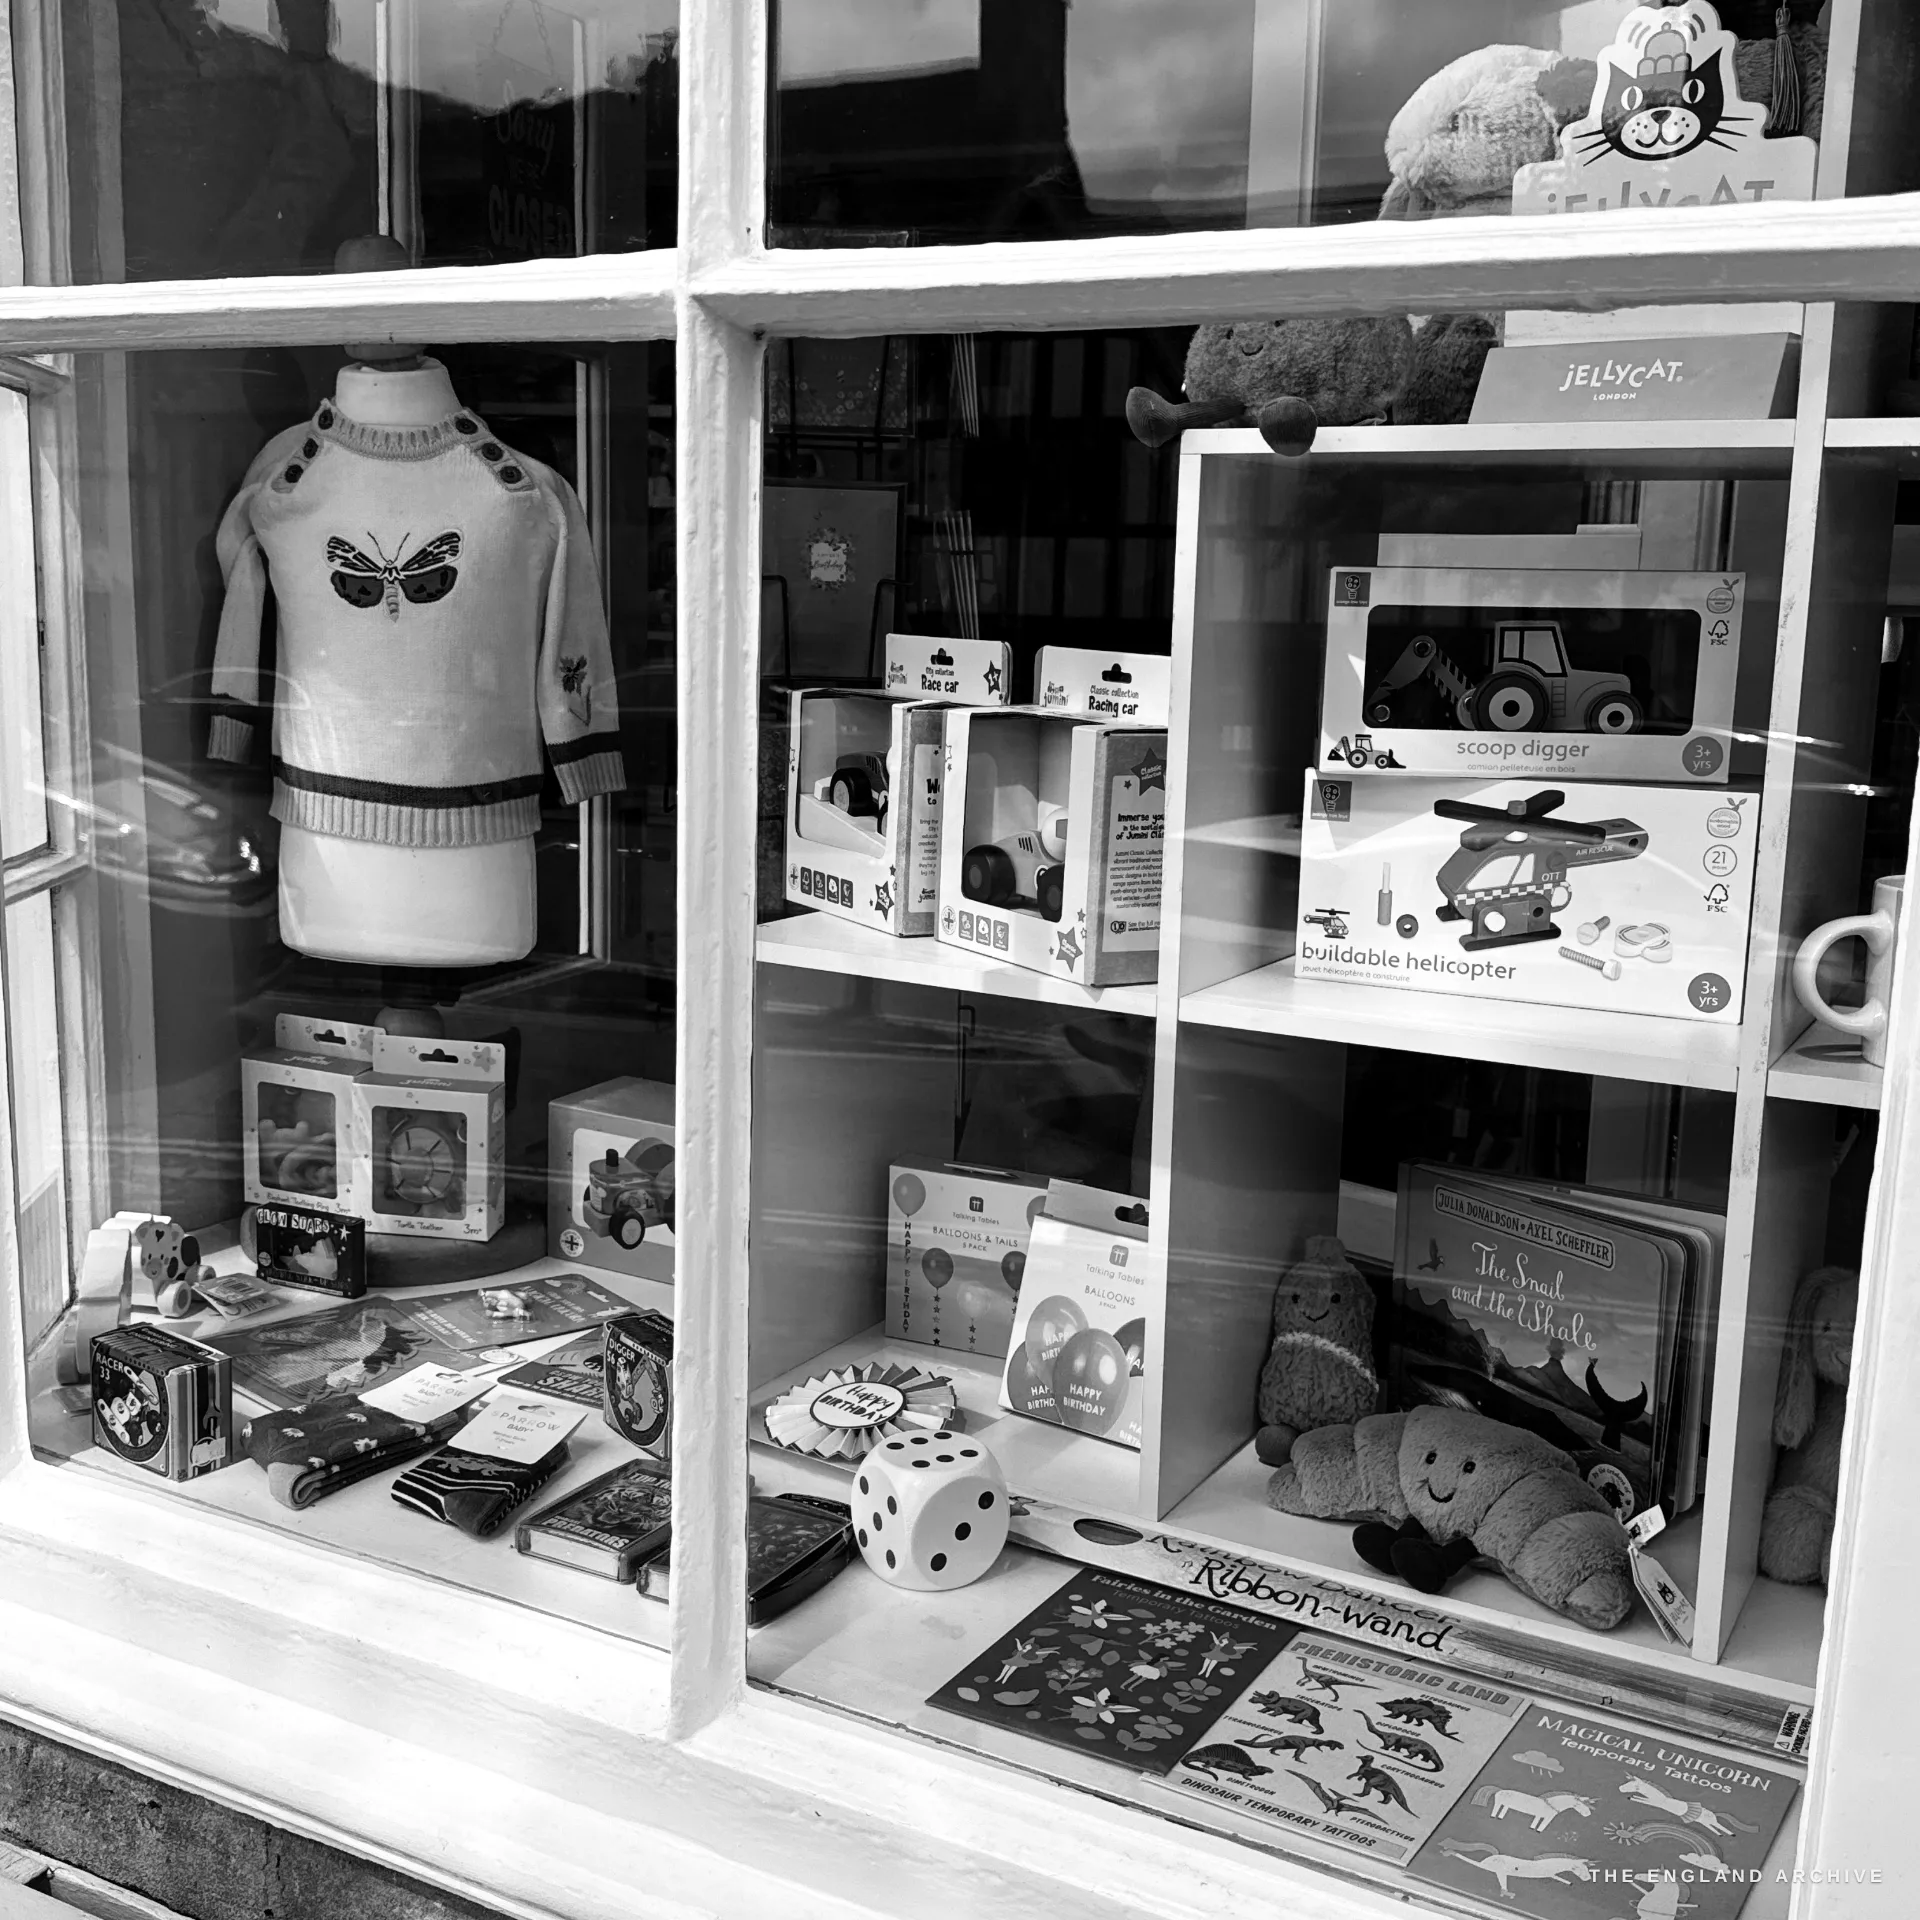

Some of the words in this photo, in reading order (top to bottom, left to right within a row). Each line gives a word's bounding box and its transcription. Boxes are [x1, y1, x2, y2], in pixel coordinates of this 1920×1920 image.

[489, 184, 574, 256] CLOSED
[1593, 392, 1637, 401] LONDON
[921, 674, 942, 692] Race
[944, 680, 960, 693] car
[1088, 695, 1119, 718] Racing
[1122, 703, 1139, 715] car
[1456, 741, 1516, 758] scoop
[1522, 739, 1590, 761] digger
[1695, 744, 1712, 758] 3+
[1467, 763, 1499, 771] camion
[1500, 763, 1544, 773] pelleteuse
[1557, 764, 1576, 773] bois
[1693, 759, 1712, 770] yrs
[1118, 813, 1150, 822] Immerse
[1116, 831, 1124, 840] of
[1576, 848, 1588, 857] AIR
[1589, 844, 1614, 856] RESCUE
[1712, 850, 1727, 864] 21
[1541, 871, 1562, 882] OTT
[1706, 904, 1729, 913] FSC
[1302, 941, 1400, 968] buildable
[1406, 951, 1517, 981] helicopter
[1301, 964, 1322, 974] jouet
[1372, 973, 1410, 982] construire
[1700, 980, 1718, 994] 3+
[1699, 996, 1718, 1008] yrs
[257, 1208, 288, 1228] GLOW
[291, 1213, 330, 1236] STARS
[952, 1211, 976, 1223] Talking
[977, 1215, 1000, 1226] Tables
[1438, 1192, 1464, 1212] JULIA
[1466, 1201, 1520, 1232] DONALDSON
[1526, 1221, 1554, 1242] AXEL
[1555, 1230, 1610, 1262] SCHEFFLER
[932, 1226, 982, 1242] BALLOONS
[985, 1235, 992, 1244] &
[995, 1236, 1018, 1248] TAILS
[968, 1242, 988, 1252] PACK
[1086, 1263, 1115, 1280] Talking
[1117, 1271, 1145, 1286] Tables
[1471, 1242, 1510, 1283] The
[1511, 1252, 1566, 1301] Snail
[1084, 1284, 1136, 1306] BALLOONS
[1450, 1284, 1484, 1311] and
[1483, 1288, 1516, 1322] the
[1516, 1294, 1598, 1352] Whale
[606, 1350, 616, 1365] 56
[609, 1338, 636, 1363] DIGGER
[95, 1352, 125, 1374] RACER
[100, 1366, 111, 1381] 33
[846, 1385, 896, 1412] Happy
[1069, 1383, 1102, 1401] HAPPY
[819, 1394, 888, 1423] BIRTHDAY
[1063, 1396, 1107, 1417] BIRTHDAY
[490, 1410, 561, 1432] SPARROW
[541, 1517, 630, 1549] PREDATORS
[1145, 1534, 1310, 1580] Rainbow
[1312, 1579, 1461, 1624] Dancer
[1091, 1574, 1152, 1595] Fairies
[1153, 1589, 1172, 1601] in
[1175, 1596, 1205, 1609] the
[1207, 1605, 1277, 1631] Garden
[1112, 1589, 1188, 1615] Temporary
[1189, 1609, 1240, 1630] Tattoos
[1446, 1681, 1511, 1706] LAND
[1536, 1715, 1645, 1755] MAGICAL
[1656, 1747, 1772, 1792] UNICORN
[1560, 1737, 1656, 1772] Temporary
[1664, 1765, 1733, 1794] Tattoos
[1225, 1776, 1277, 1796] DIMETRODON
[1180, 1776, 1243, 1803] DINOSAUR
[1243, 1797, 1321, 1829] TEMPORARY
[1321, 1824, 1378, 1848] TATTOOS
[1349, 1816, 1416, 1843] PTERODACTYLUS
